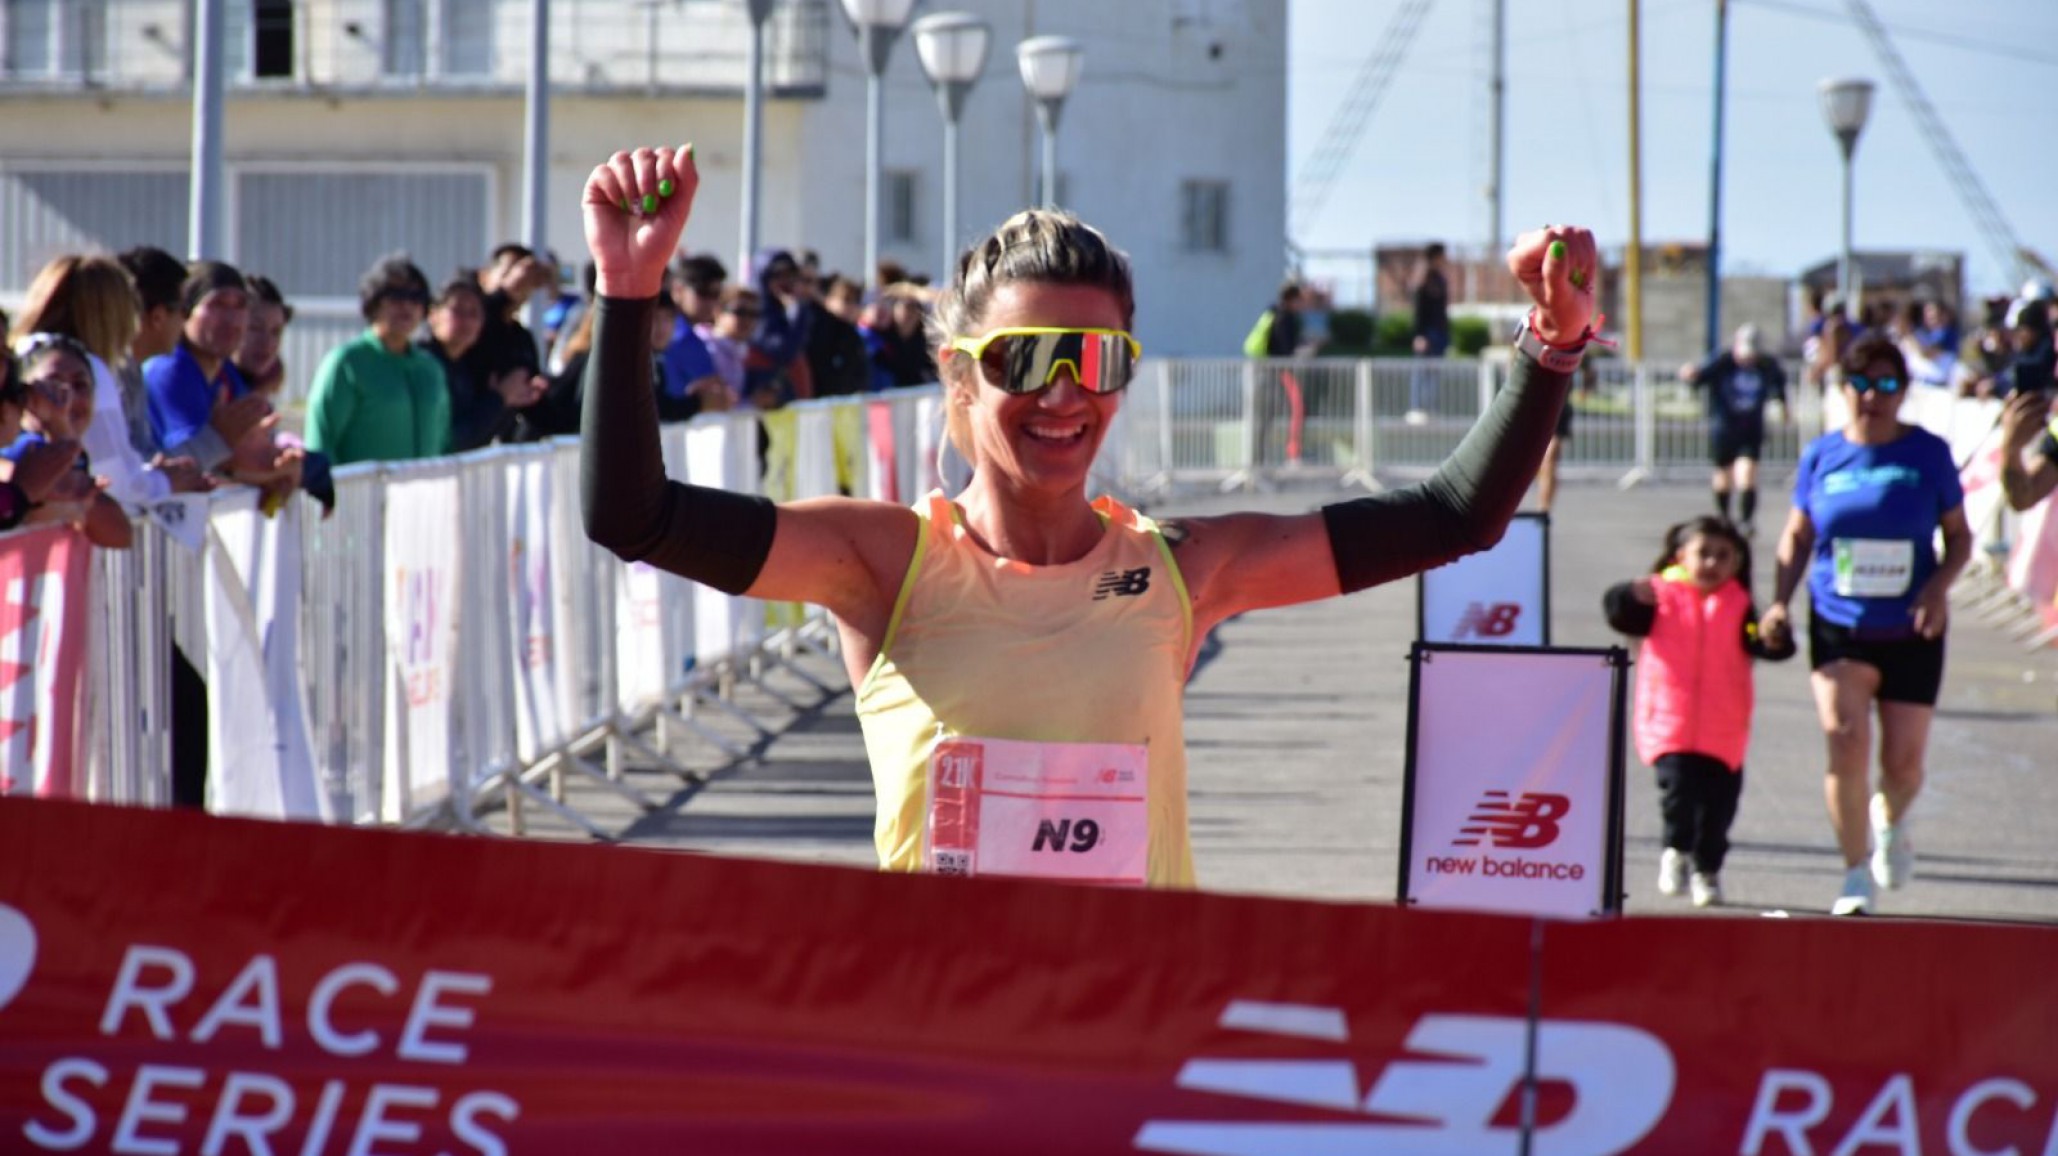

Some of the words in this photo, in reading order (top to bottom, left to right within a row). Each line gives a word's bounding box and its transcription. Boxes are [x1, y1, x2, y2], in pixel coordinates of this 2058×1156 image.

[1092, 566, 1151, 601] NB
[1032, 818, 1099, 853] N9
[1451, 790, 1571, 849] NB
[1426, 856, 1476, 874] new
[1482, 856, 1585, 881] balance
[100, 944, 493, 1064] RACE
[22, 1057, 521, 1156] SERIES
[1738, 1068, 2058, 1156] RAC
